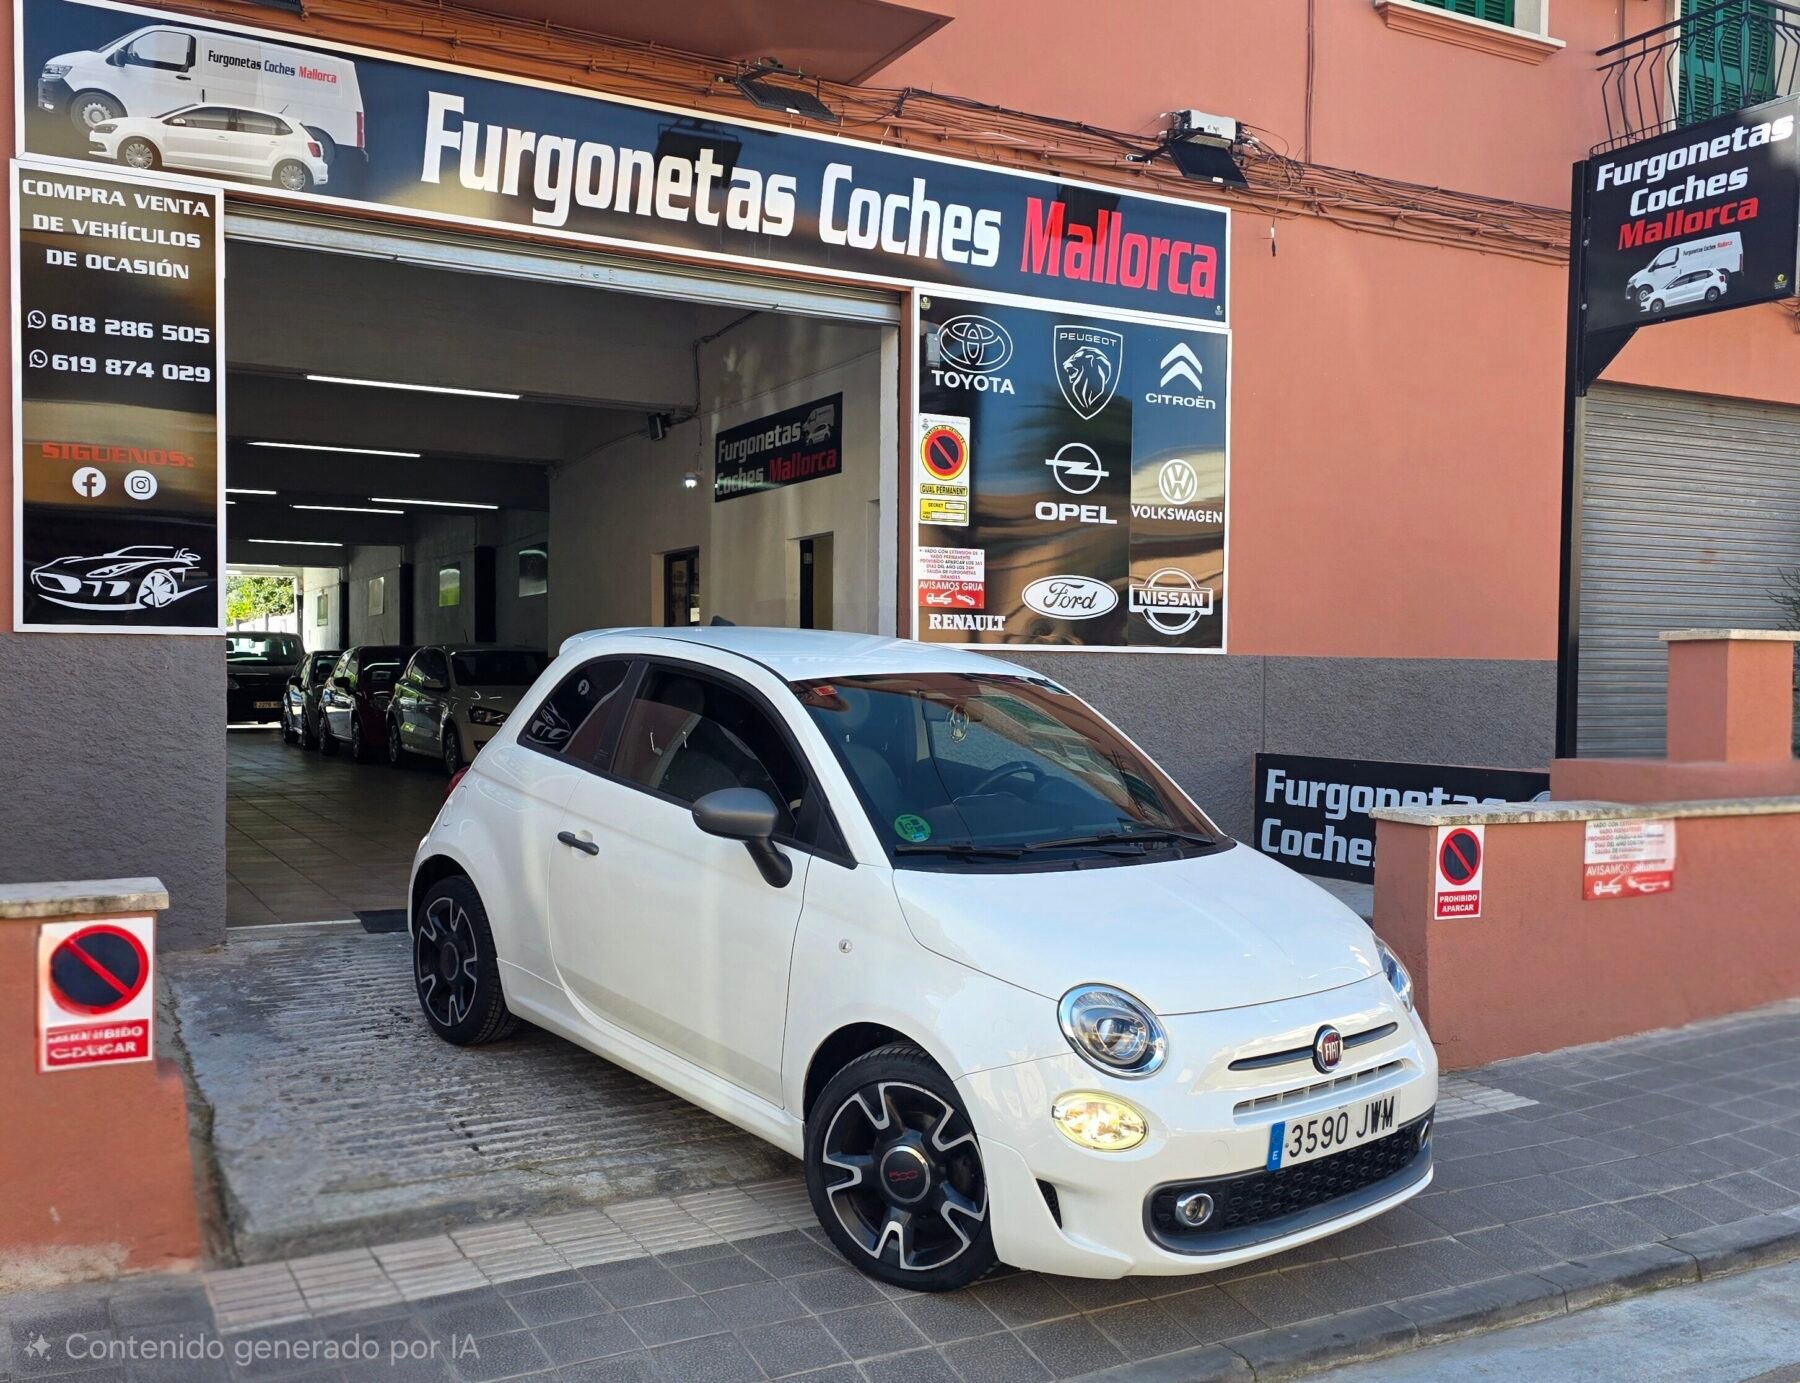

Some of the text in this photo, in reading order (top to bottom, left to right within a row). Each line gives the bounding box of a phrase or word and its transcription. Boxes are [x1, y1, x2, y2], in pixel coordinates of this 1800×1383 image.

[208, 49, 337, 83] Furgonetas Coches Mallorca
[1596, 114, 1794, 192] Furgonetas
[23, 179, 210, 218] COMPRA VENTA
[421, 91, 1217, 298] Furgonetas Coches Mallorca
[1629, 166, 1749, 217] Coches
[33, 214, 200, 248] DE VEHÍCULOS
[1617, 197, 1760, 250] Mallorca
[46, 249, 189, 280] DE OCASIÓN
[51, 313, 210, 344] 618 286 505
[1060, 332, 1117, 346] PEUGEOT
[52, 354, 211, 383] 619 874 029
[931, 369, 1015, 395] TOYOTA
[718, 422, 801, 464] Furgonetas
[716, 448, 837, 496] Coches Mallorca
[936, 486, 966, 495] PERMANENT
[1035, 501, 1118, 524] OPEL
[1131, 505, 1223, 524] VOLKSWAGEN
[919, 581, 984, 592] AVISAMOS GRUA
[1043, 582, 1098, 610] Ford
[1139, 591, 1204, 607] NISSAN
[928, 614, 1006, 632] RENAULT
[1265, 769, 1507, 820] Furgonet
[1261, 818, 1376, 868] Coche
[1586, 863, 1630, 877] AVISAMOS
[1439, 894, 1478, 903] PROHIBIDO
[1441, 904, 1474, 913] APARCAR
[1324, 1040, 1341, 1062] FIAT
[1289, 1111, 1349, 1158] 3590
[1356, 1096, 1395, 1138] JWM
